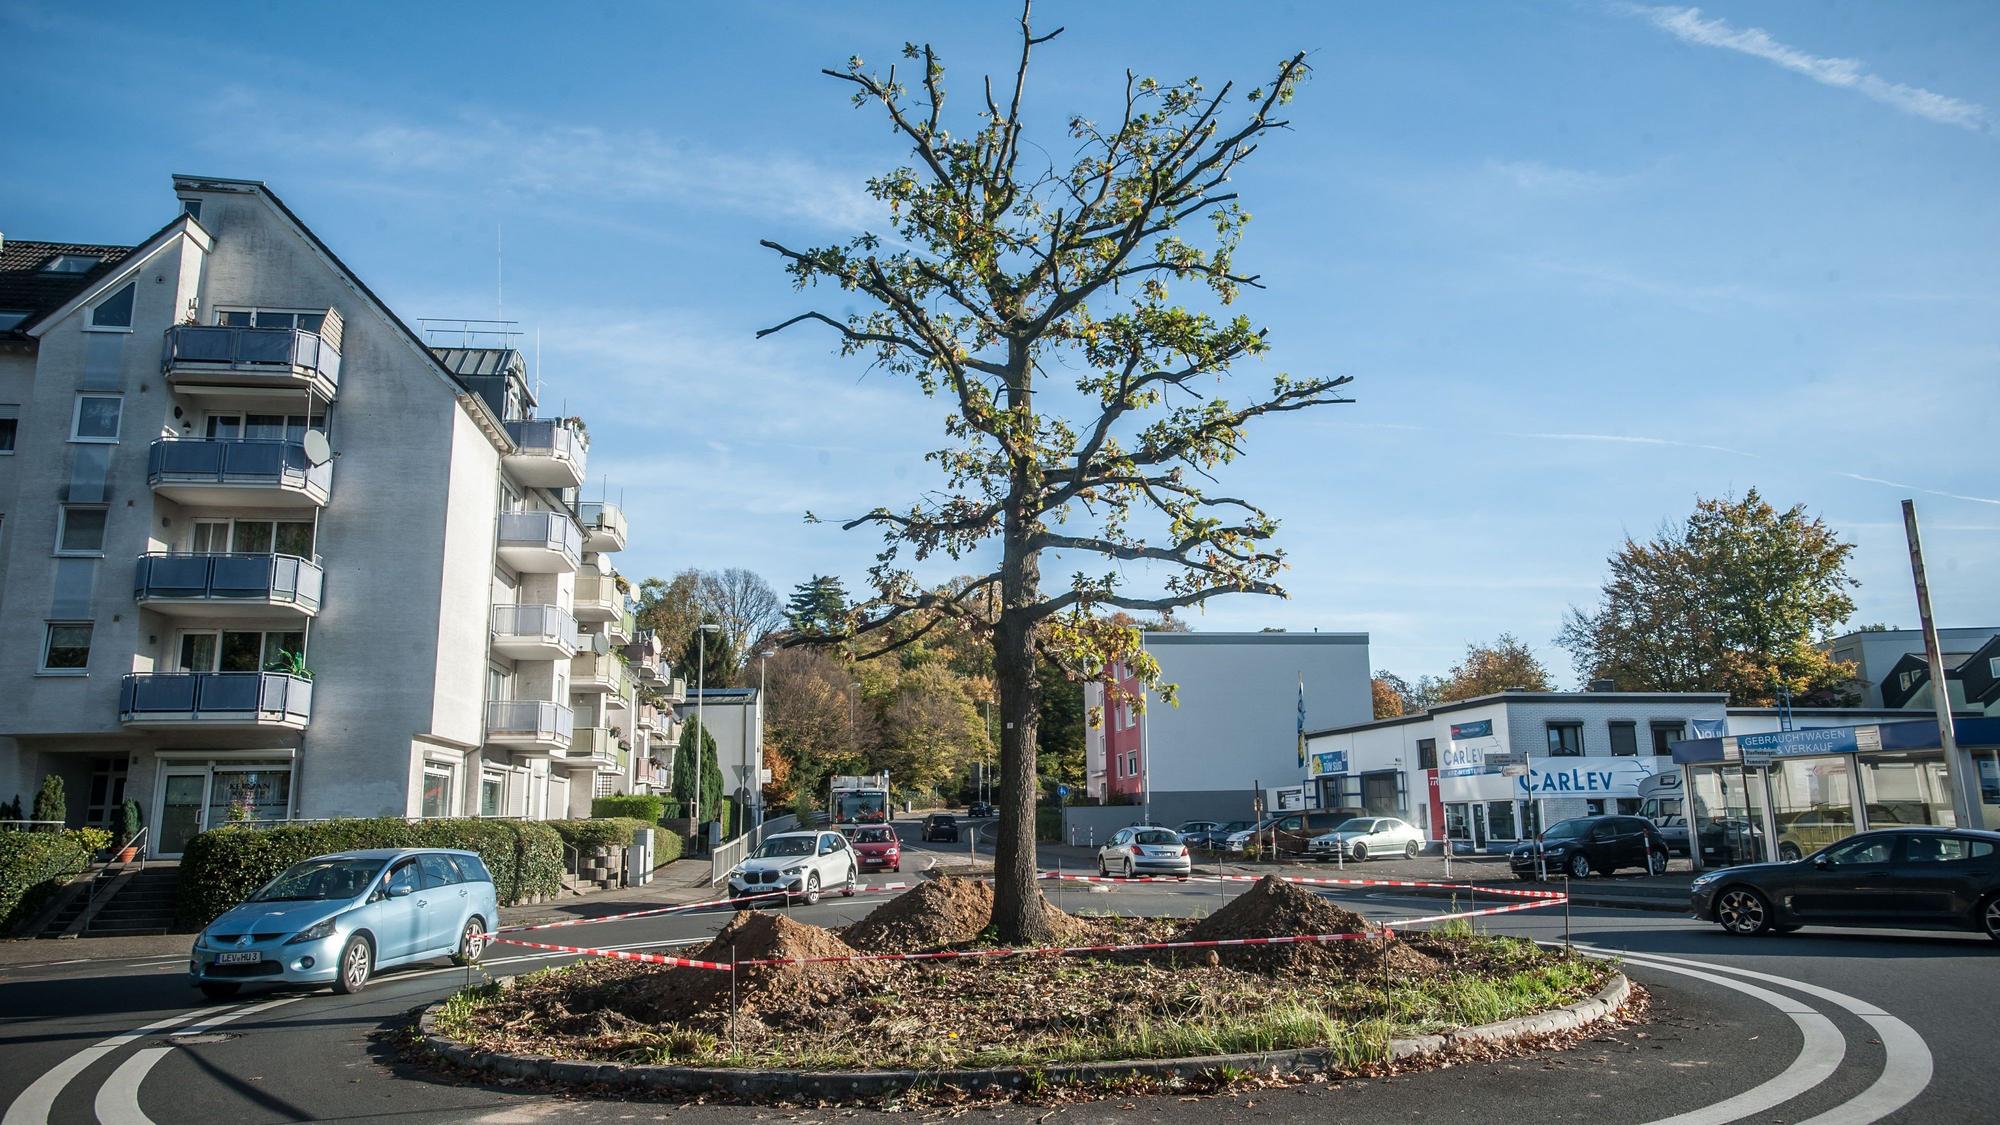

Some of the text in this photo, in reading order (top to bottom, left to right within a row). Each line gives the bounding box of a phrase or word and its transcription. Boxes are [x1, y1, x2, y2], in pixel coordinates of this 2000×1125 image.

[1744, 729, 1846, 746] GEBRAUCHTWAGEN
[1443, 746, 1484, 766] CARLEV
[1784, 741, 1833, 754] VERKAUF
[1519, 764, 1613, 792] CARLEV
[221, 953, 238, 963] LEV
